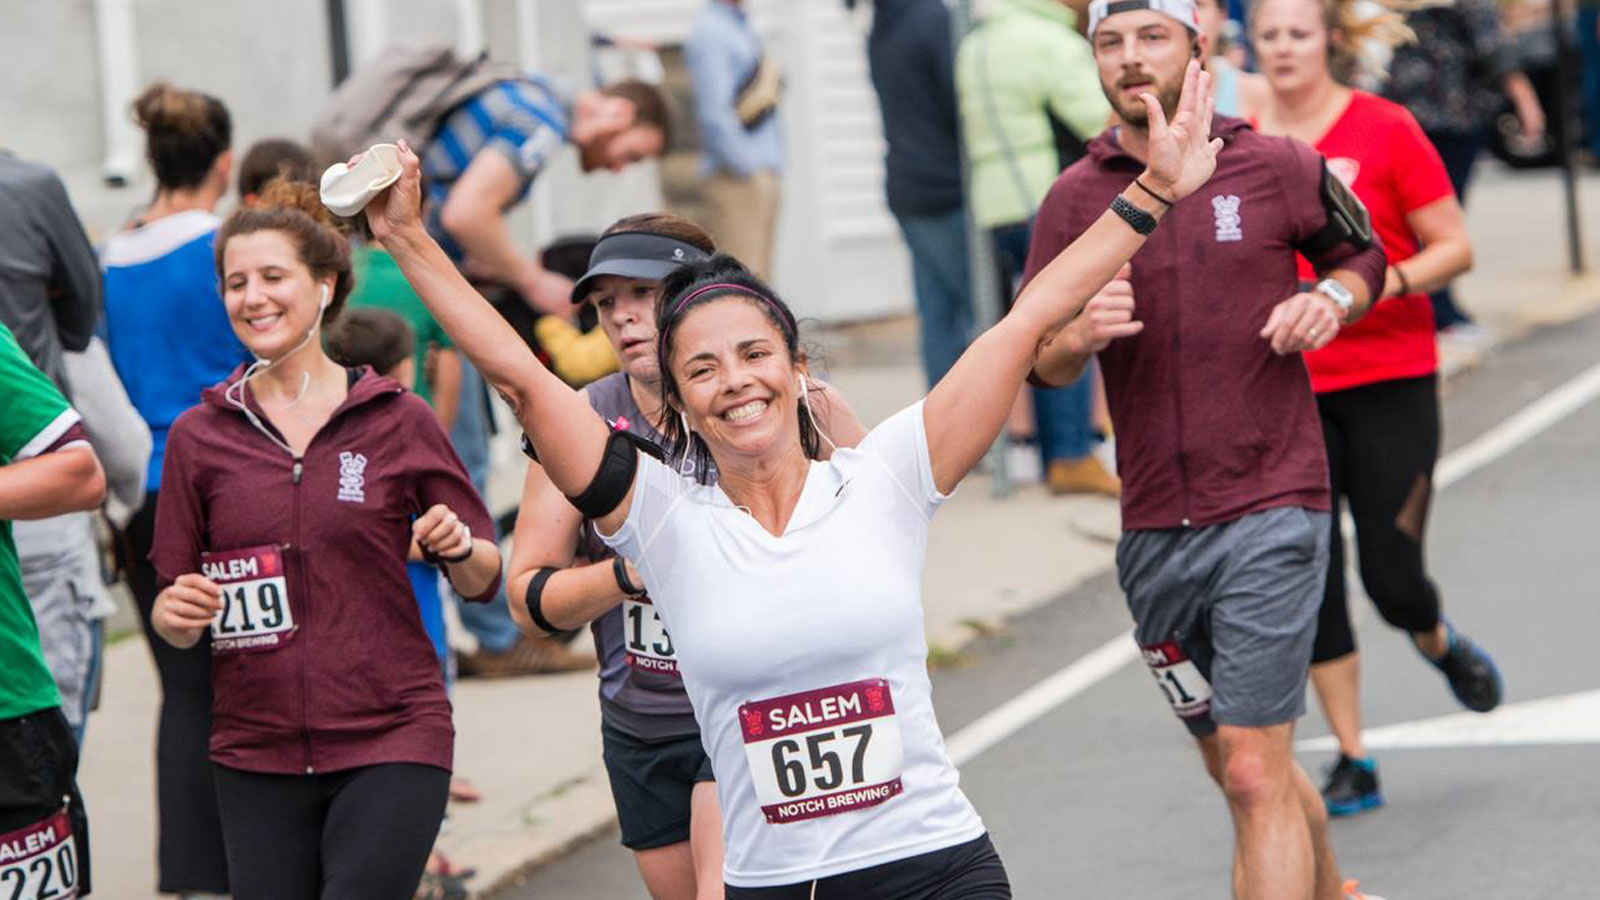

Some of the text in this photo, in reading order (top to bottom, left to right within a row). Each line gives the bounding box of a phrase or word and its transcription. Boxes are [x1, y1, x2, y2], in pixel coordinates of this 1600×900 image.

[201, 556, 258, 580] SALEM
[212, 583, 283, 634] 219
[635, 656, 674, 671] NOTCH
[769, 692, 862, 731] SALEM
[771, 724, 873, 797] 657
[778, 786, 889, 819] NOTCH BREWING
[1, 844, 75, 900] 220
